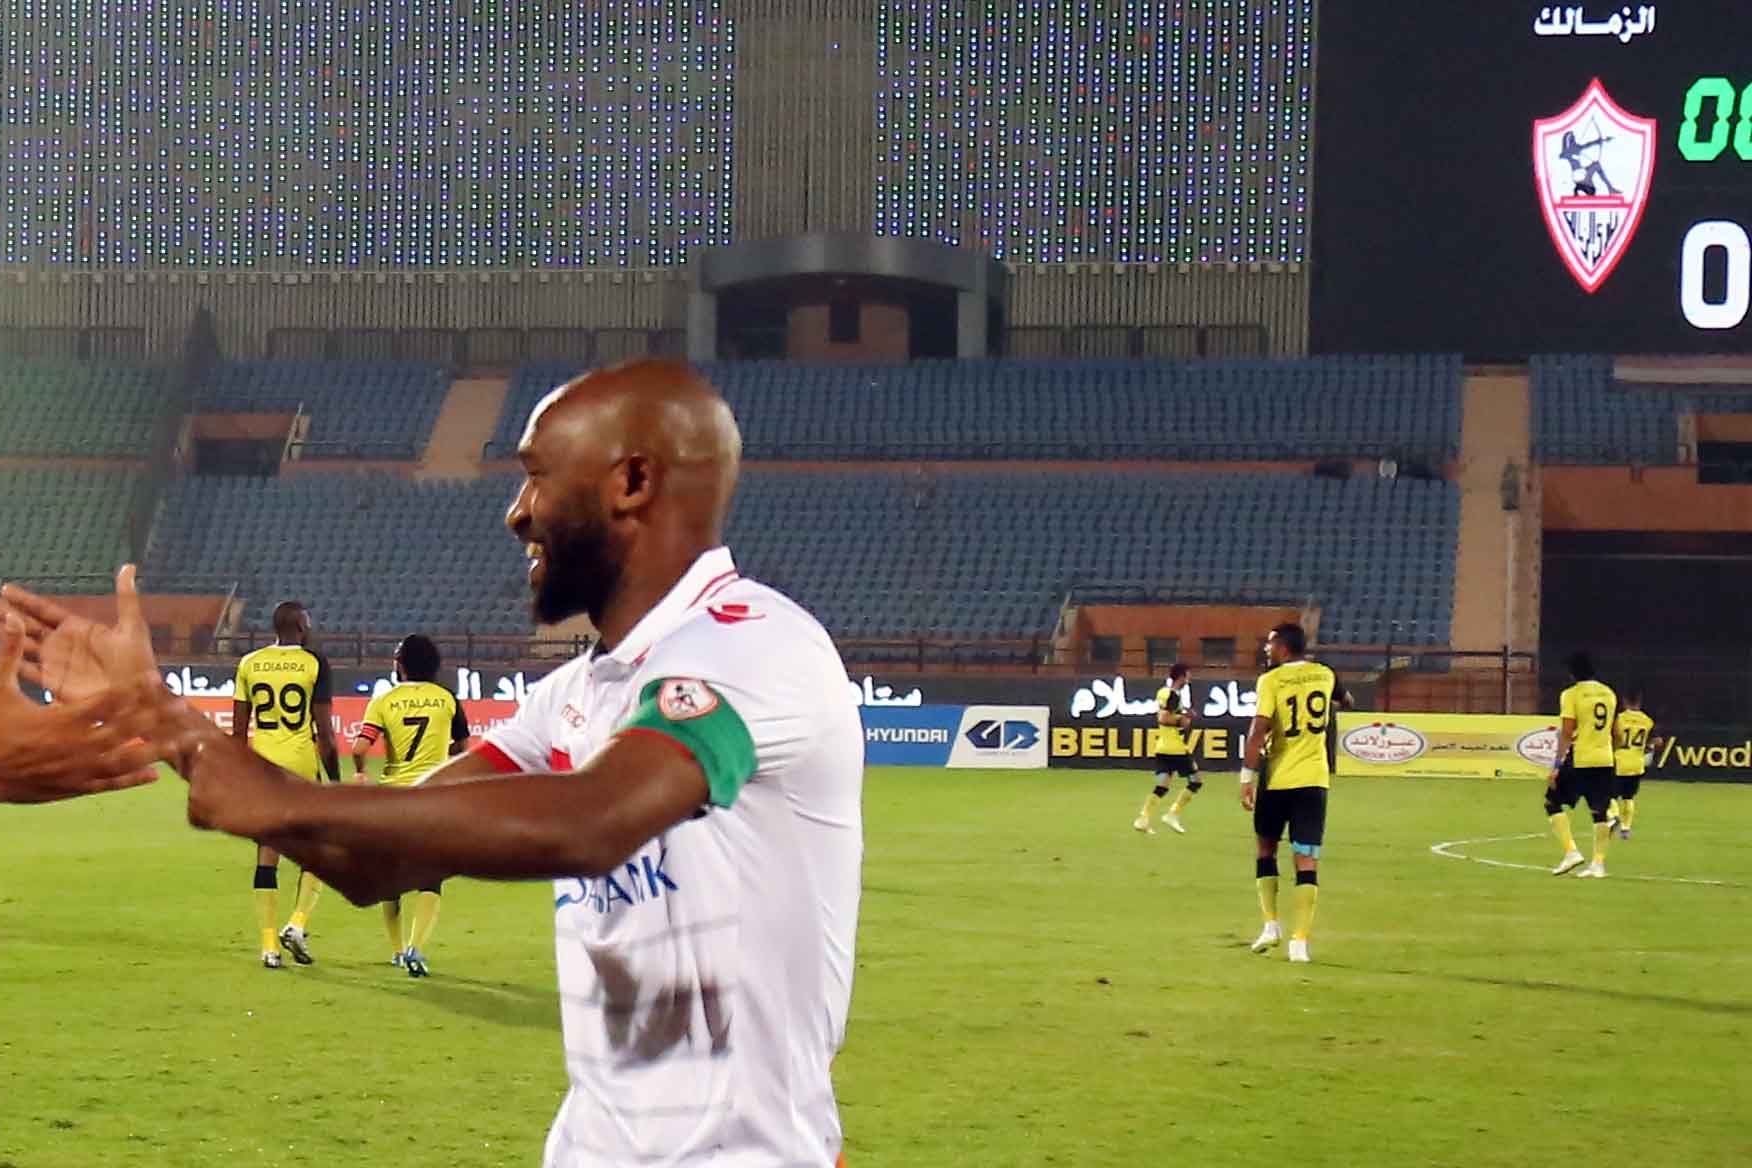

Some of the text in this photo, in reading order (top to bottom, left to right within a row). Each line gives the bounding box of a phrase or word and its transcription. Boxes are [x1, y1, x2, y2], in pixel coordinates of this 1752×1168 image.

[1533, 5, 1656, 44] الزمالك
[1678, 77, 1752, 162] 0
[1681, 220, 1751, 329] 0
[253, 662, 305, 673] B.DIARRA
[251, 682, 307, 731] 29
[390, 699, 446, 712] M.TALAAT
[1071, 676, 1192, 718] اسلام
[1284, 690, 1326, 738] 19
[1593, 702, 1608, 731] 9
[403, 717, 429, 761] 7
[866, 728, 948, 743] HYUNDAI
[1623, 728, 1646, 750] 14
